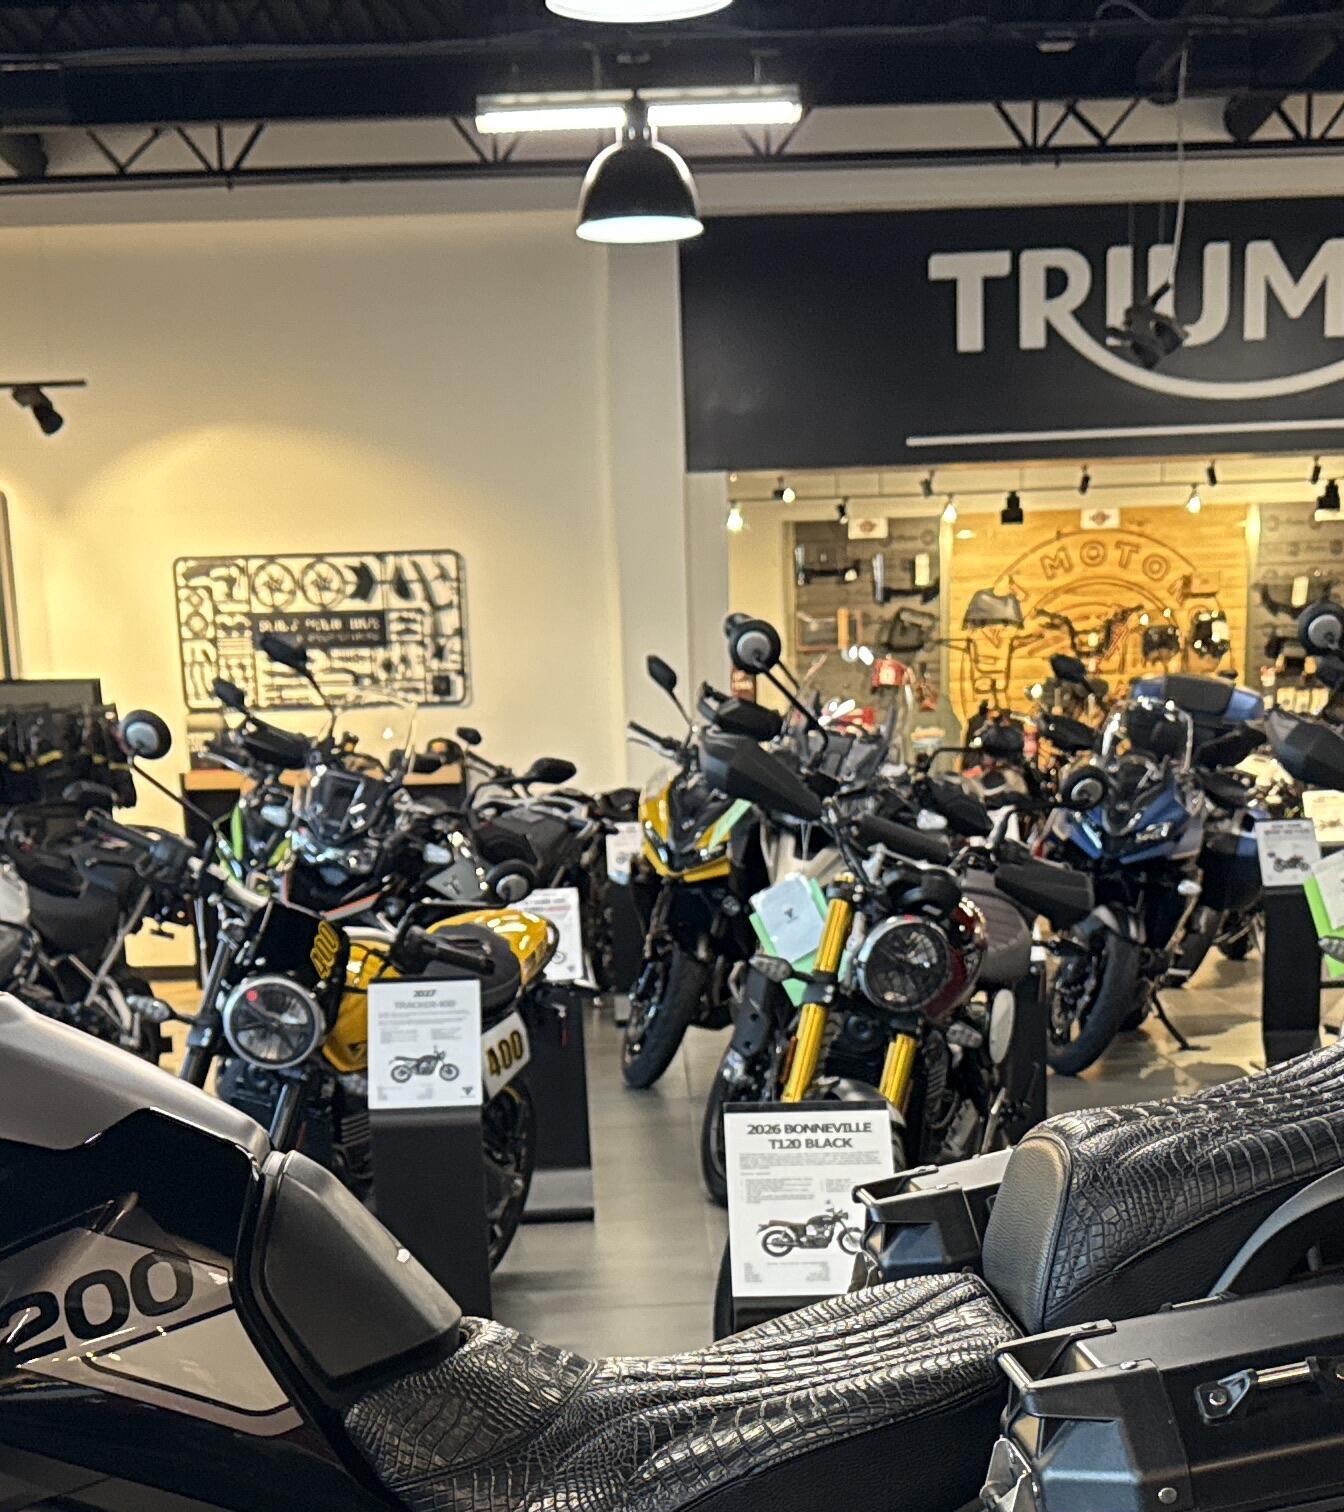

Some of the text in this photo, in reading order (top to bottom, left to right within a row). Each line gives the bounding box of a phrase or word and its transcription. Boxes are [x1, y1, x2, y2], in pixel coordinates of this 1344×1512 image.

[310, 920, 340, 979] 400
[486, 1030, 523, 1077] 400
[746, 1122, 872, 1135] 2026 BONNEVILLE
[768, 1137, 853, 1150] T120 BLACK
